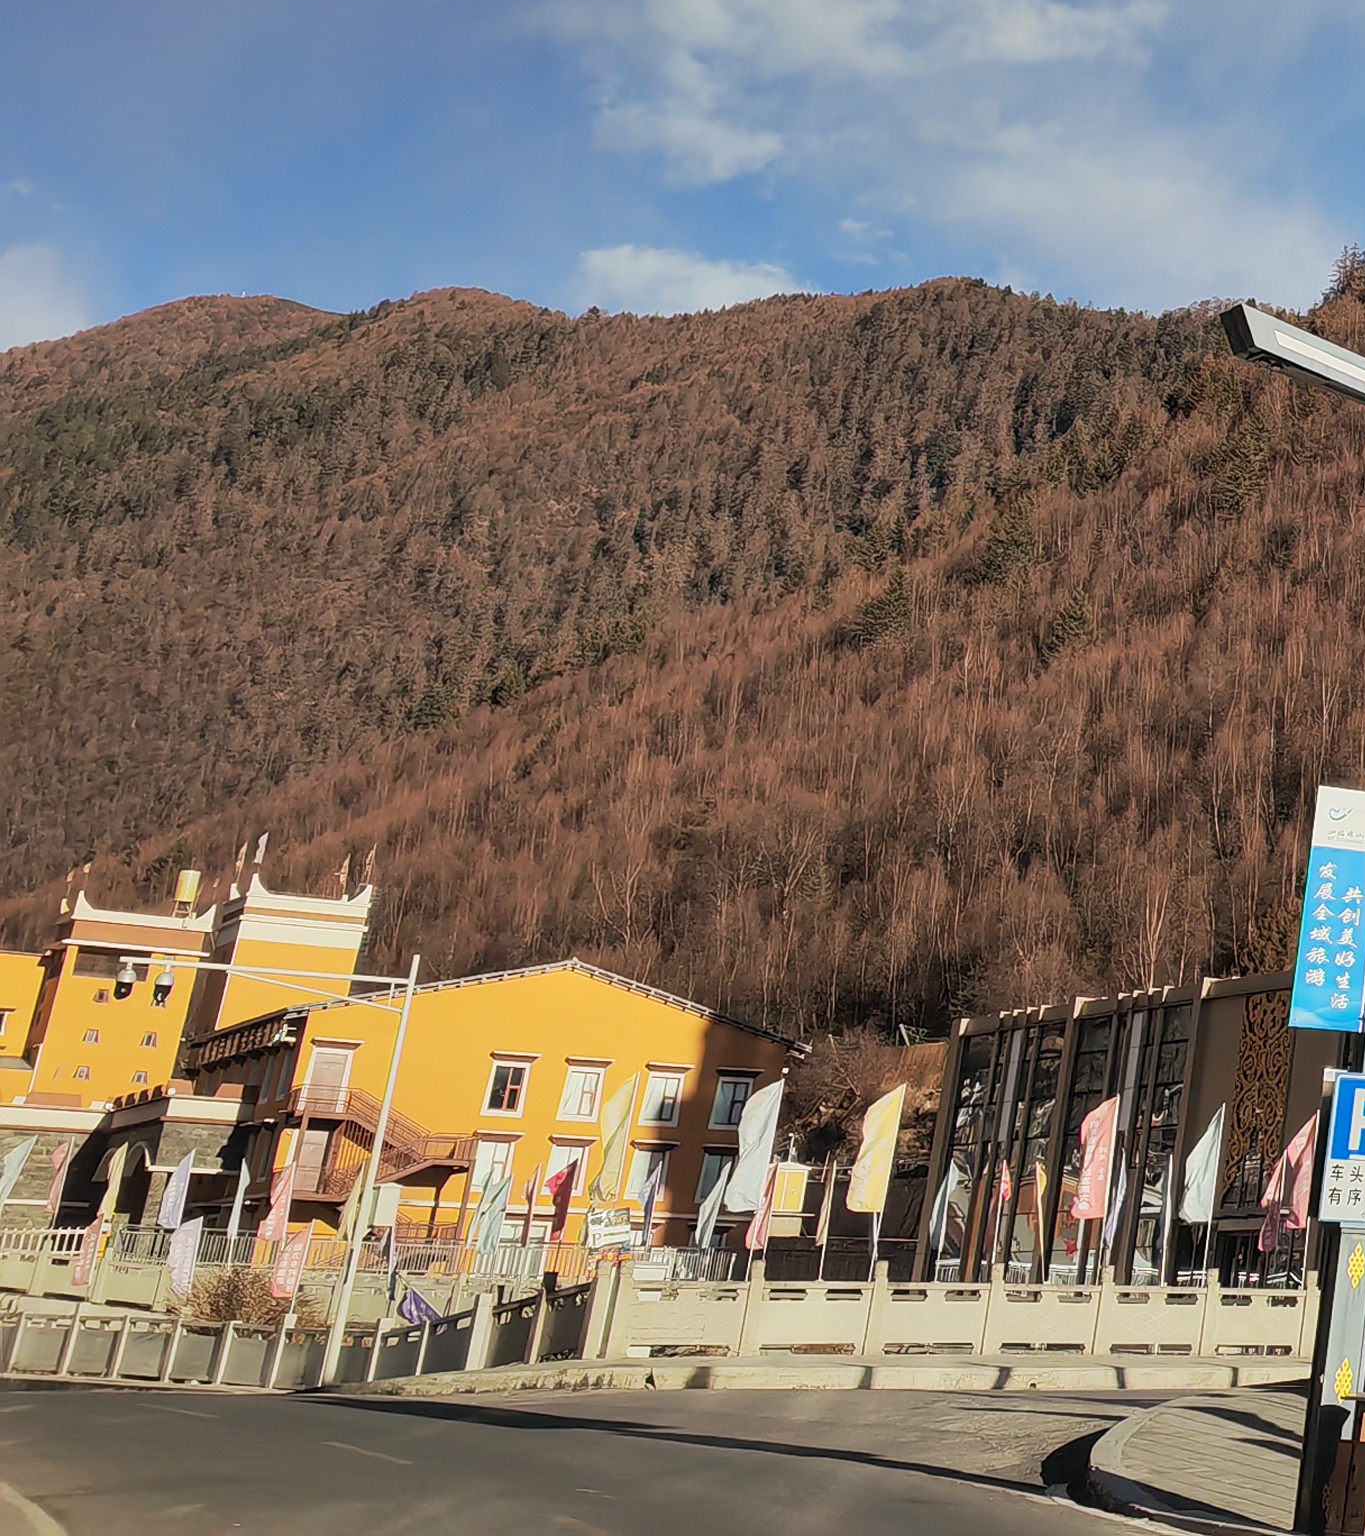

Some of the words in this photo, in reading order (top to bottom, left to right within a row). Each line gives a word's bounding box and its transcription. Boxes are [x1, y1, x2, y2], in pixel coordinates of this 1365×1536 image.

[1305, 861, 1337, 987] 发展全域旅游
[1330, 886, 1364, 1009] 共创美好生活
